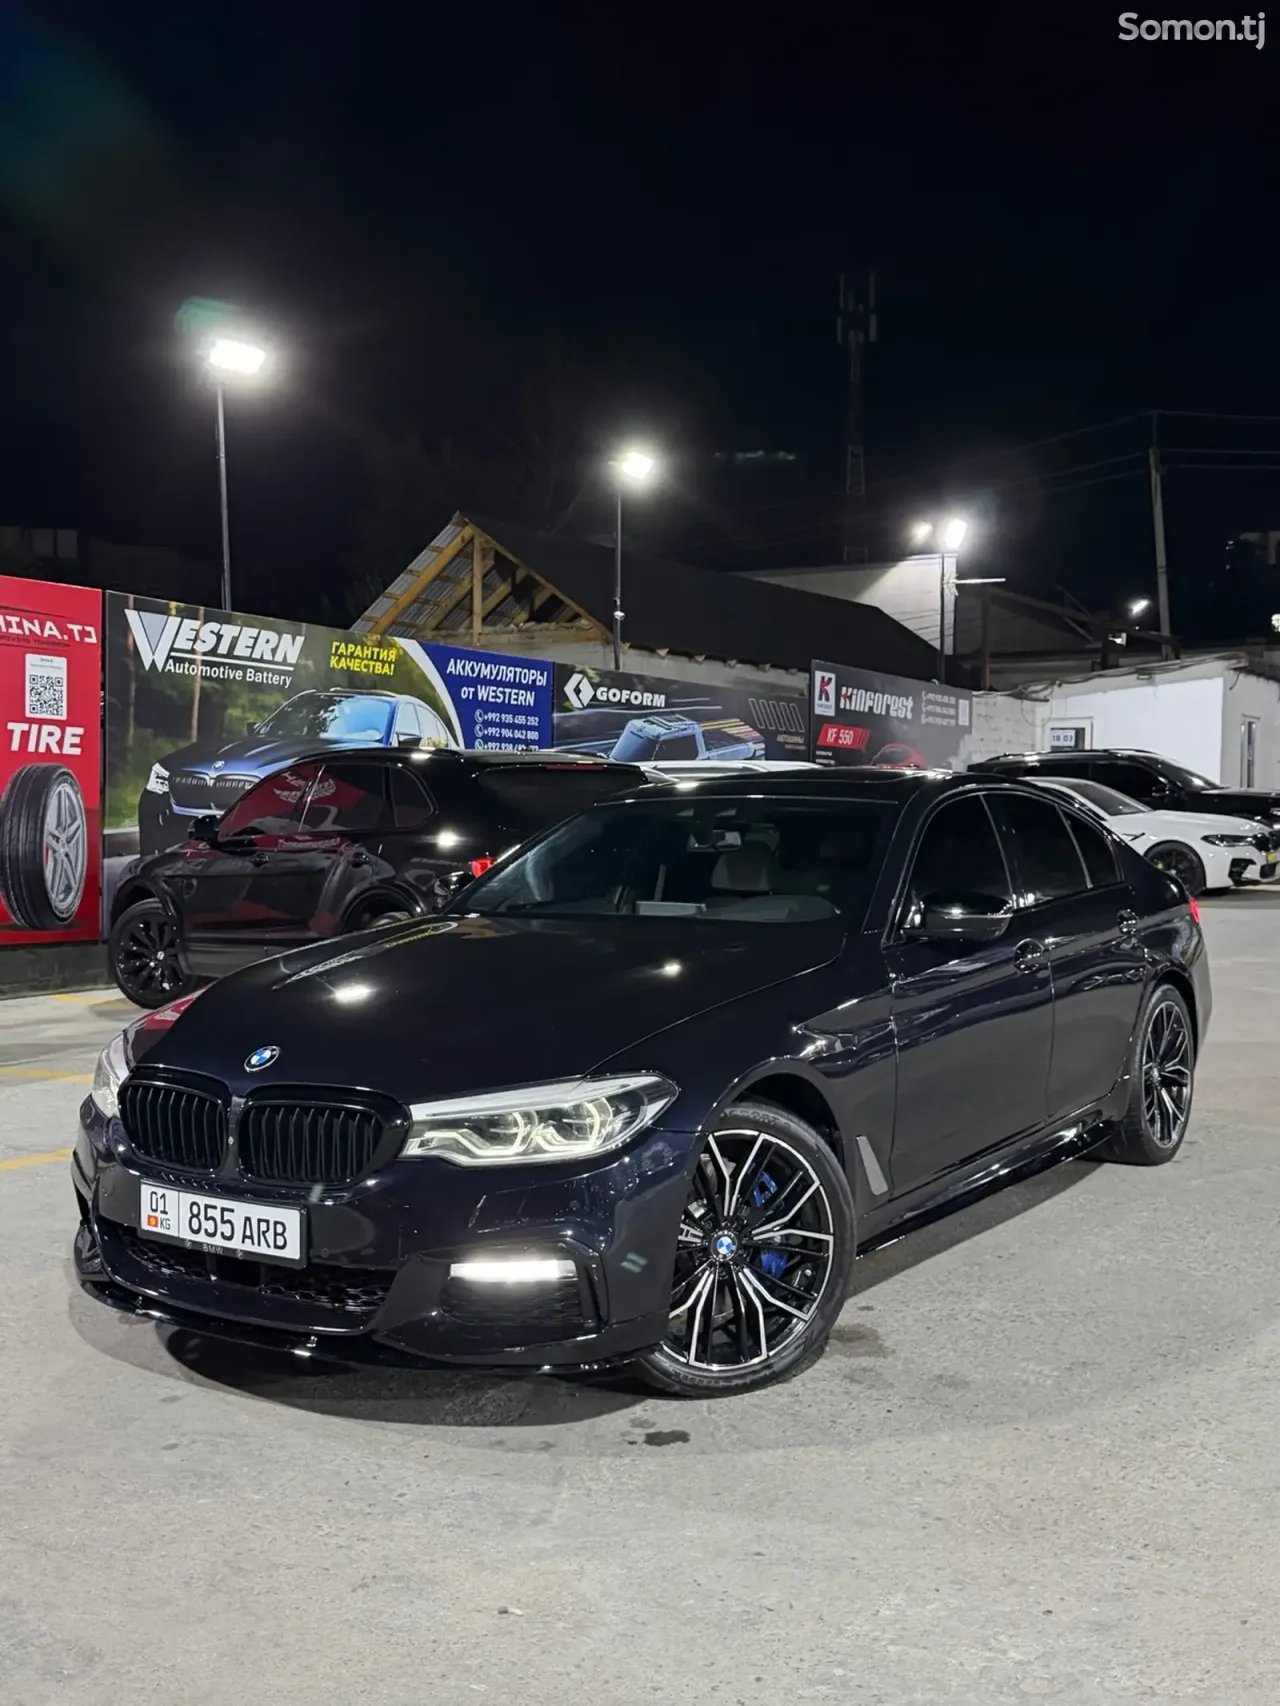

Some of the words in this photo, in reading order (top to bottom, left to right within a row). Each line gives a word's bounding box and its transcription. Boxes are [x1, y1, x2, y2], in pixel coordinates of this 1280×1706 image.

[124, 608, 304, 672] WESTERN
[332, 641, 396, 662] ГАРАНТИЯ
[164, 659, 243, 680] Automotive
[246, 668, 292, 689] Battery
[330, 656, 395, 676] КАЧЕСТВА!
[446, 658, 548, 687] АККУМУЛЯТОРЫ
[461, 687, 475, 699] от
[477, 685, 535, 707] WESTERN
[596, 686, 666, 708] GOFORM
[484, 712, 500, 722] +992
[501, 713, 513, 723] 935
[7, 722, 84, 756] TIRE
[484, 727, 500, 737] +992
[826, 728, 837, 743] KF
[838, 729, 854, 745] 550
[150, 1191, 168, 1215] 01
[188, 1201, 235, 1242] 855
[241, 1216, 287, 1250] ARB
[160, 1217, 171, 1230] KG
[202, 1243, 224, 1255] BMW
